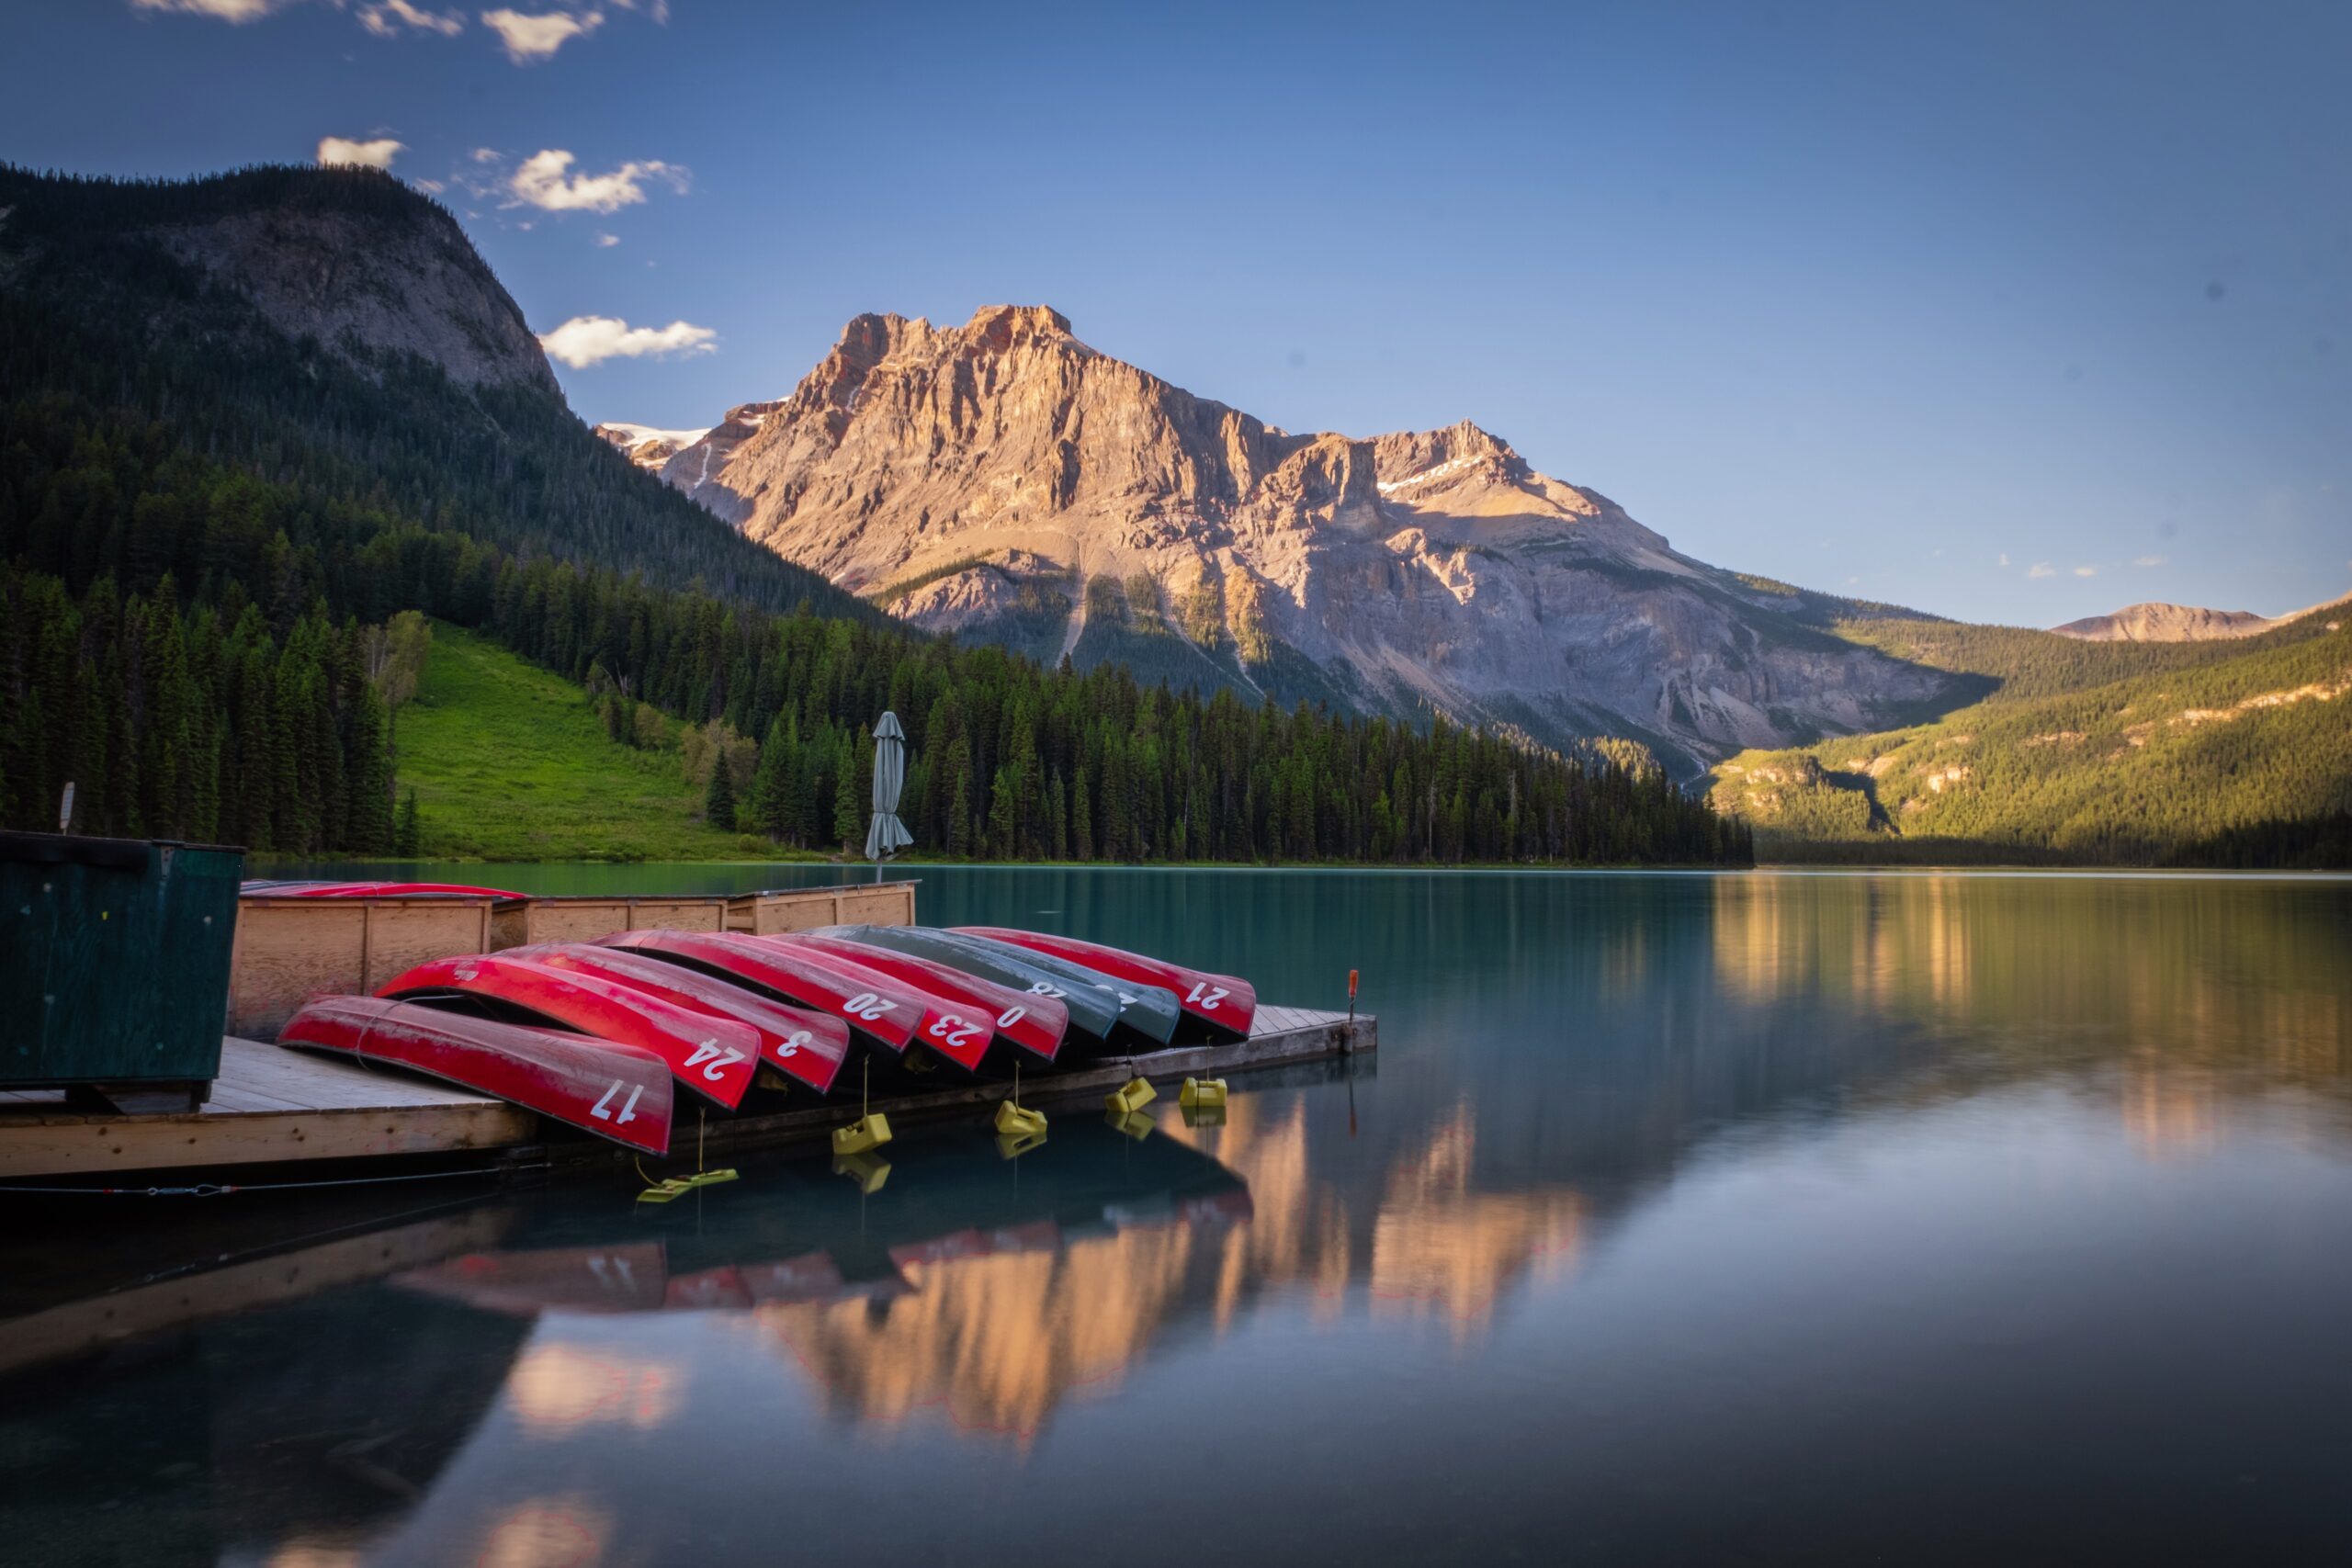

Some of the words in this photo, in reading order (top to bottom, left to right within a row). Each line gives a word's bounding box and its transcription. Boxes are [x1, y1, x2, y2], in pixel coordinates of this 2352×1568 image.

[842, 993, 899, 1021] 20
[1185, 982, 1229, 1010] 21
[929, 1015, 983, 1046] 23
[996, 1006, 1026, 1028] 0
[776, 1031, 812, 1057] 3
[684, 1038, 745, 1081] 24
[590, 1079, 644, 1124] 17
